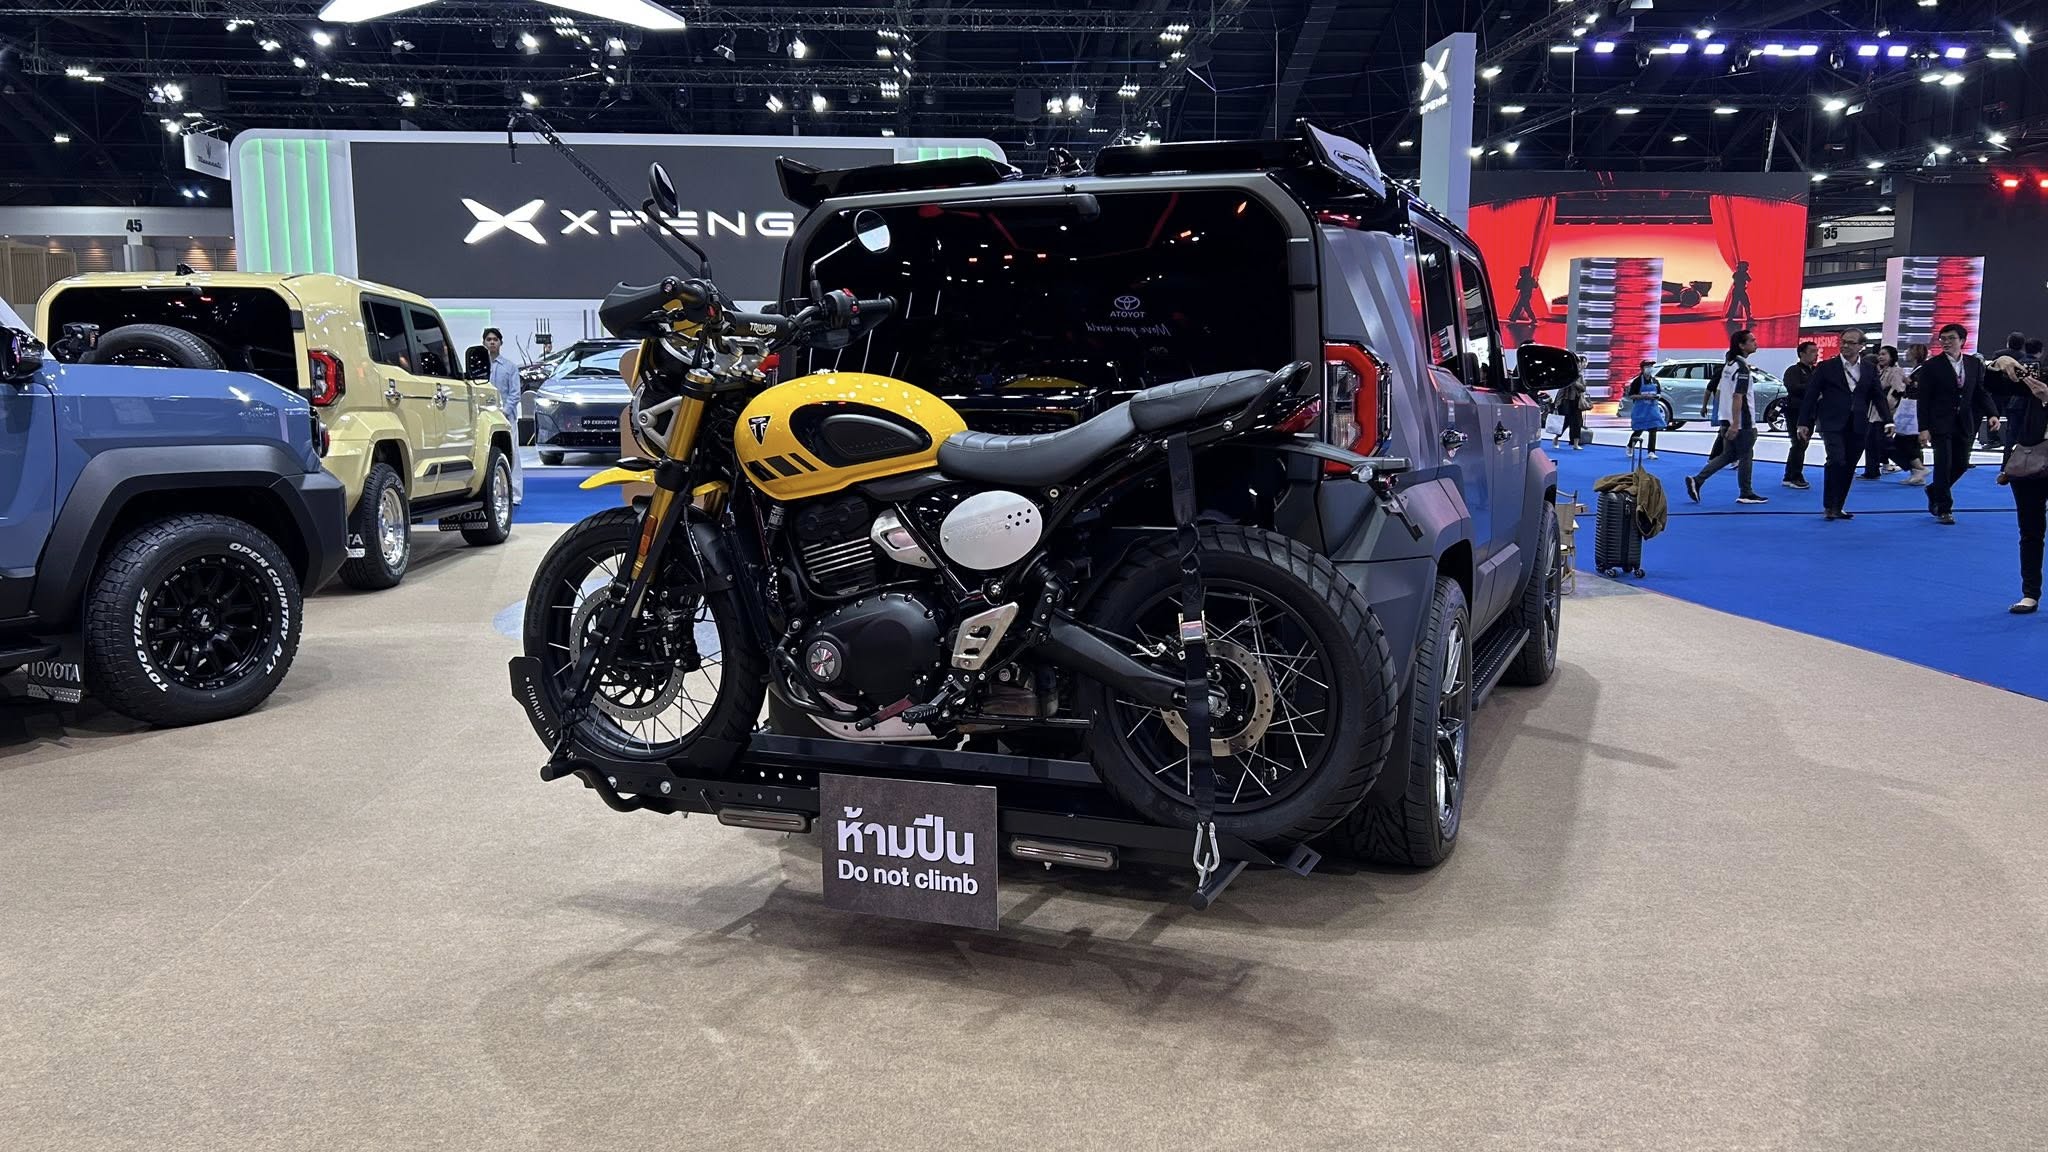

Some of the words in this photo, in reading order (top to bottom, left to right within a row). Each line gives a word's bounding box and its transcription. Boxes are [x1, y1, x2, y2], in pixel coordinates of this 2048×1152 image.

[126, 219, 143, 233] 45
[559, 209, 795, 236] XPENG
[1823, 227, 1838, 240] 35
[229, 542, 269, 568] OPEN
[133, 587, 149, 647] TIRES
[266, 568, 289, 641] COUNTRY
[137, 650, 169, 692] TOYO
[266, 643, 283, 675] A/T
[837, 806, 975, 865] ห้ามปีน
[838, 858, 869, 882] Do
[873, 866, 910, 887] not
[914, 869, 979, 895] climb
